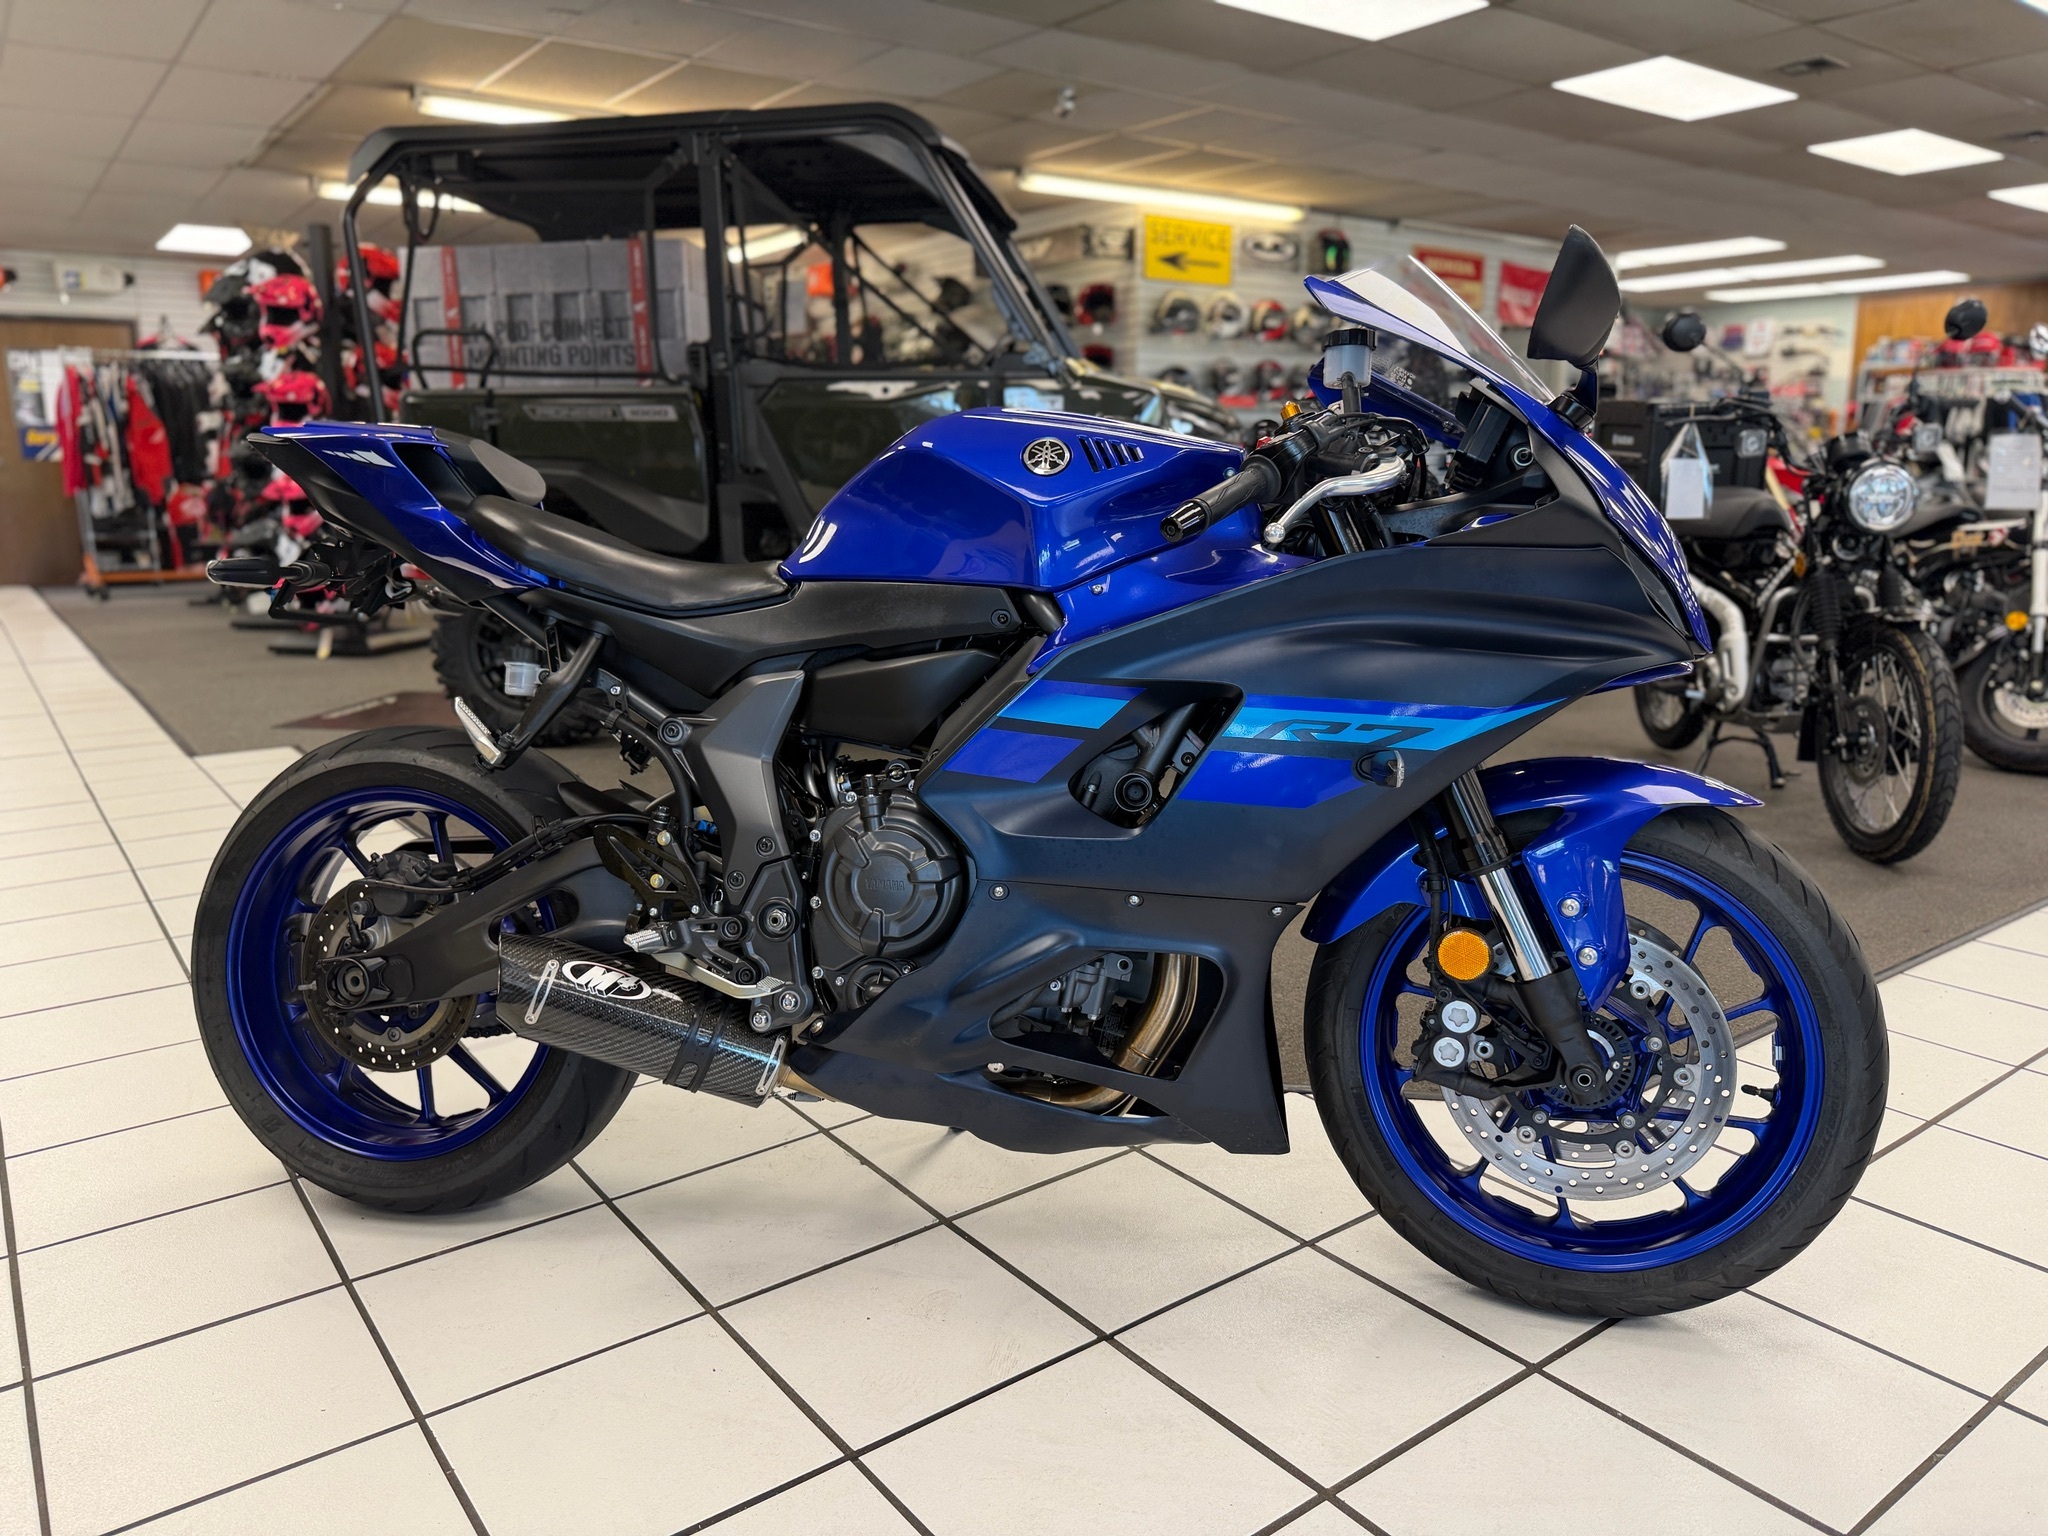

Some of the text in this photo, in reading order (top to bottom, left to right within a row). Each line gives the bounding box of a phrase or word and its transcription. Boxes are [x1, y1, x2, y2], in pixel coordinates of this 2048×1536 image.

[1150, 220, 1228, 251] SERVICE
[467, 345, 561, 368] MUNTING
[567, 344, 636, 366] POINTS
[1253, 720, 1434, 747] R7
[864, 877, 906, 892] YAMAHA
